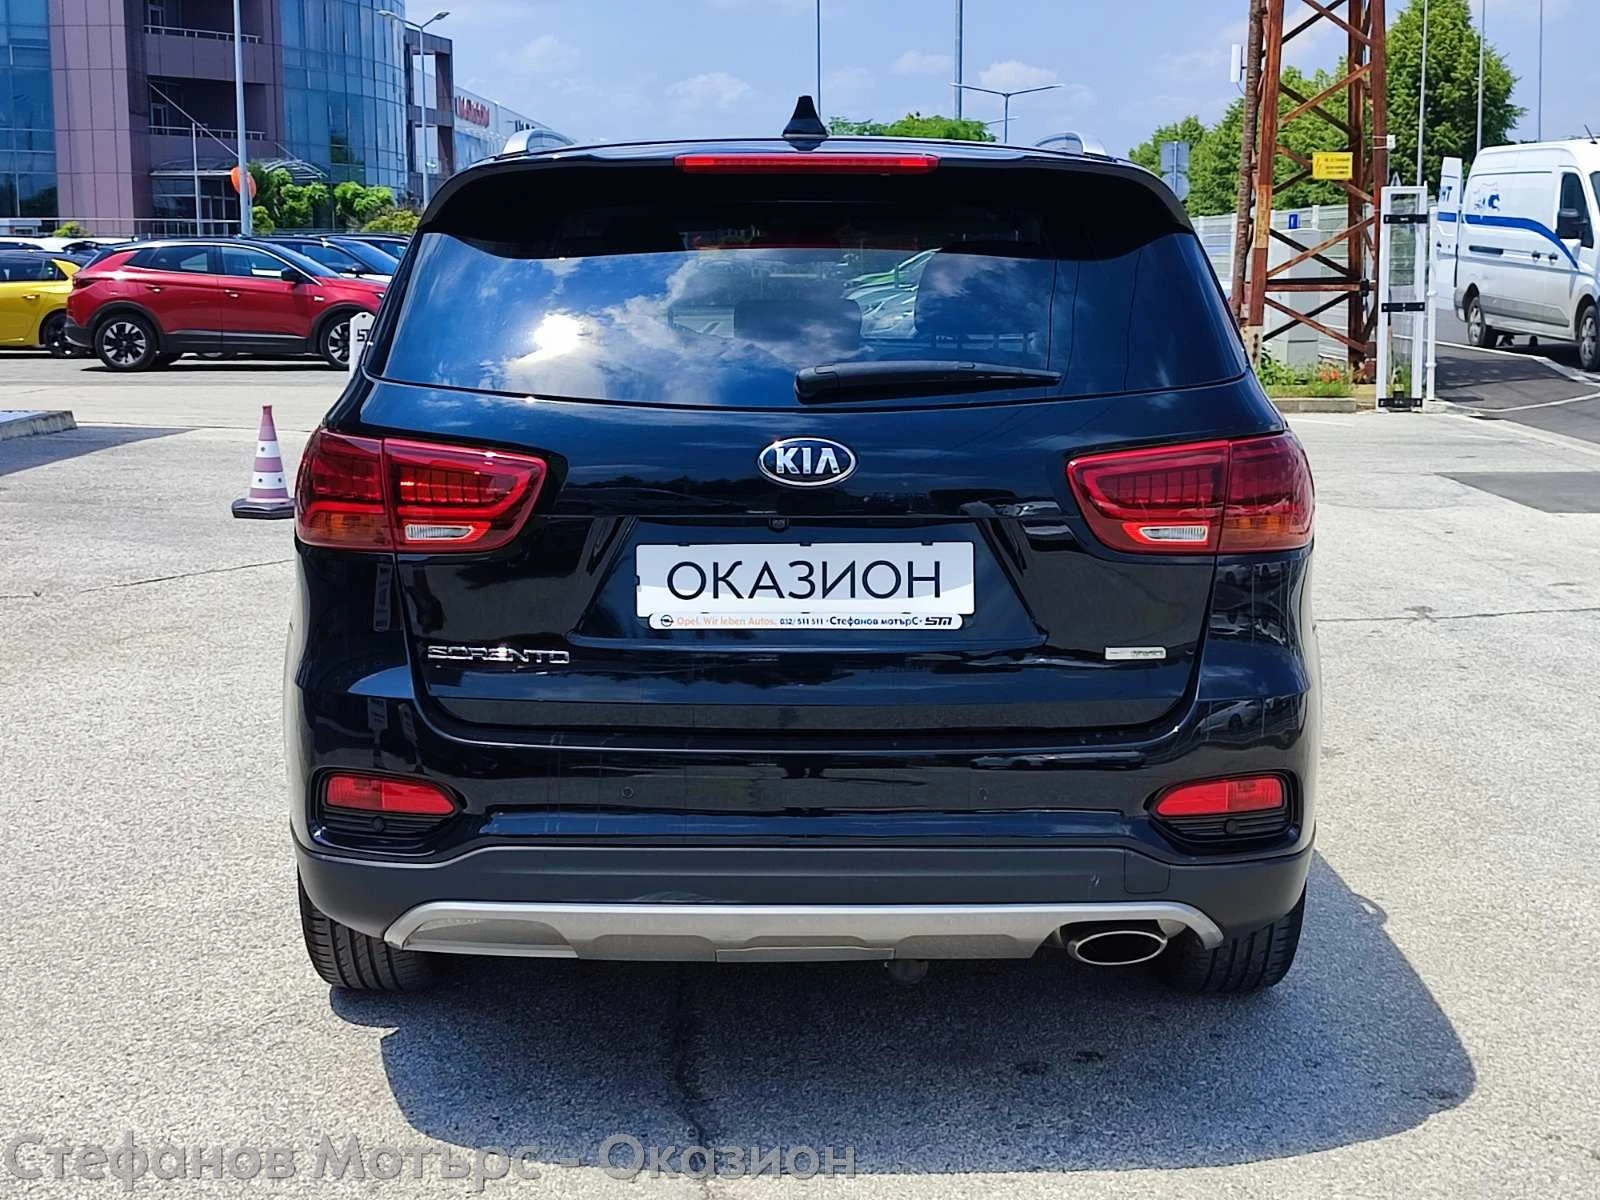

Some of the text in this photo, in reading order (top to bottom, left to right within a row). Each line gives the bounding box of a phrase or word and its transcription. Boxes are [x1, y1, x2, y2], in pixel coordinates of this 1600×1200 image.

[775, 447, 841, 475] KIA
[667, 561, 941, 601] ОКАЗИОН
[677, 616, 699, 626] Opel.
[704, 616, 720, 625] Wir
[720, 616, 746, 625] leben
[427, 645, 570, 664] SORENTO
